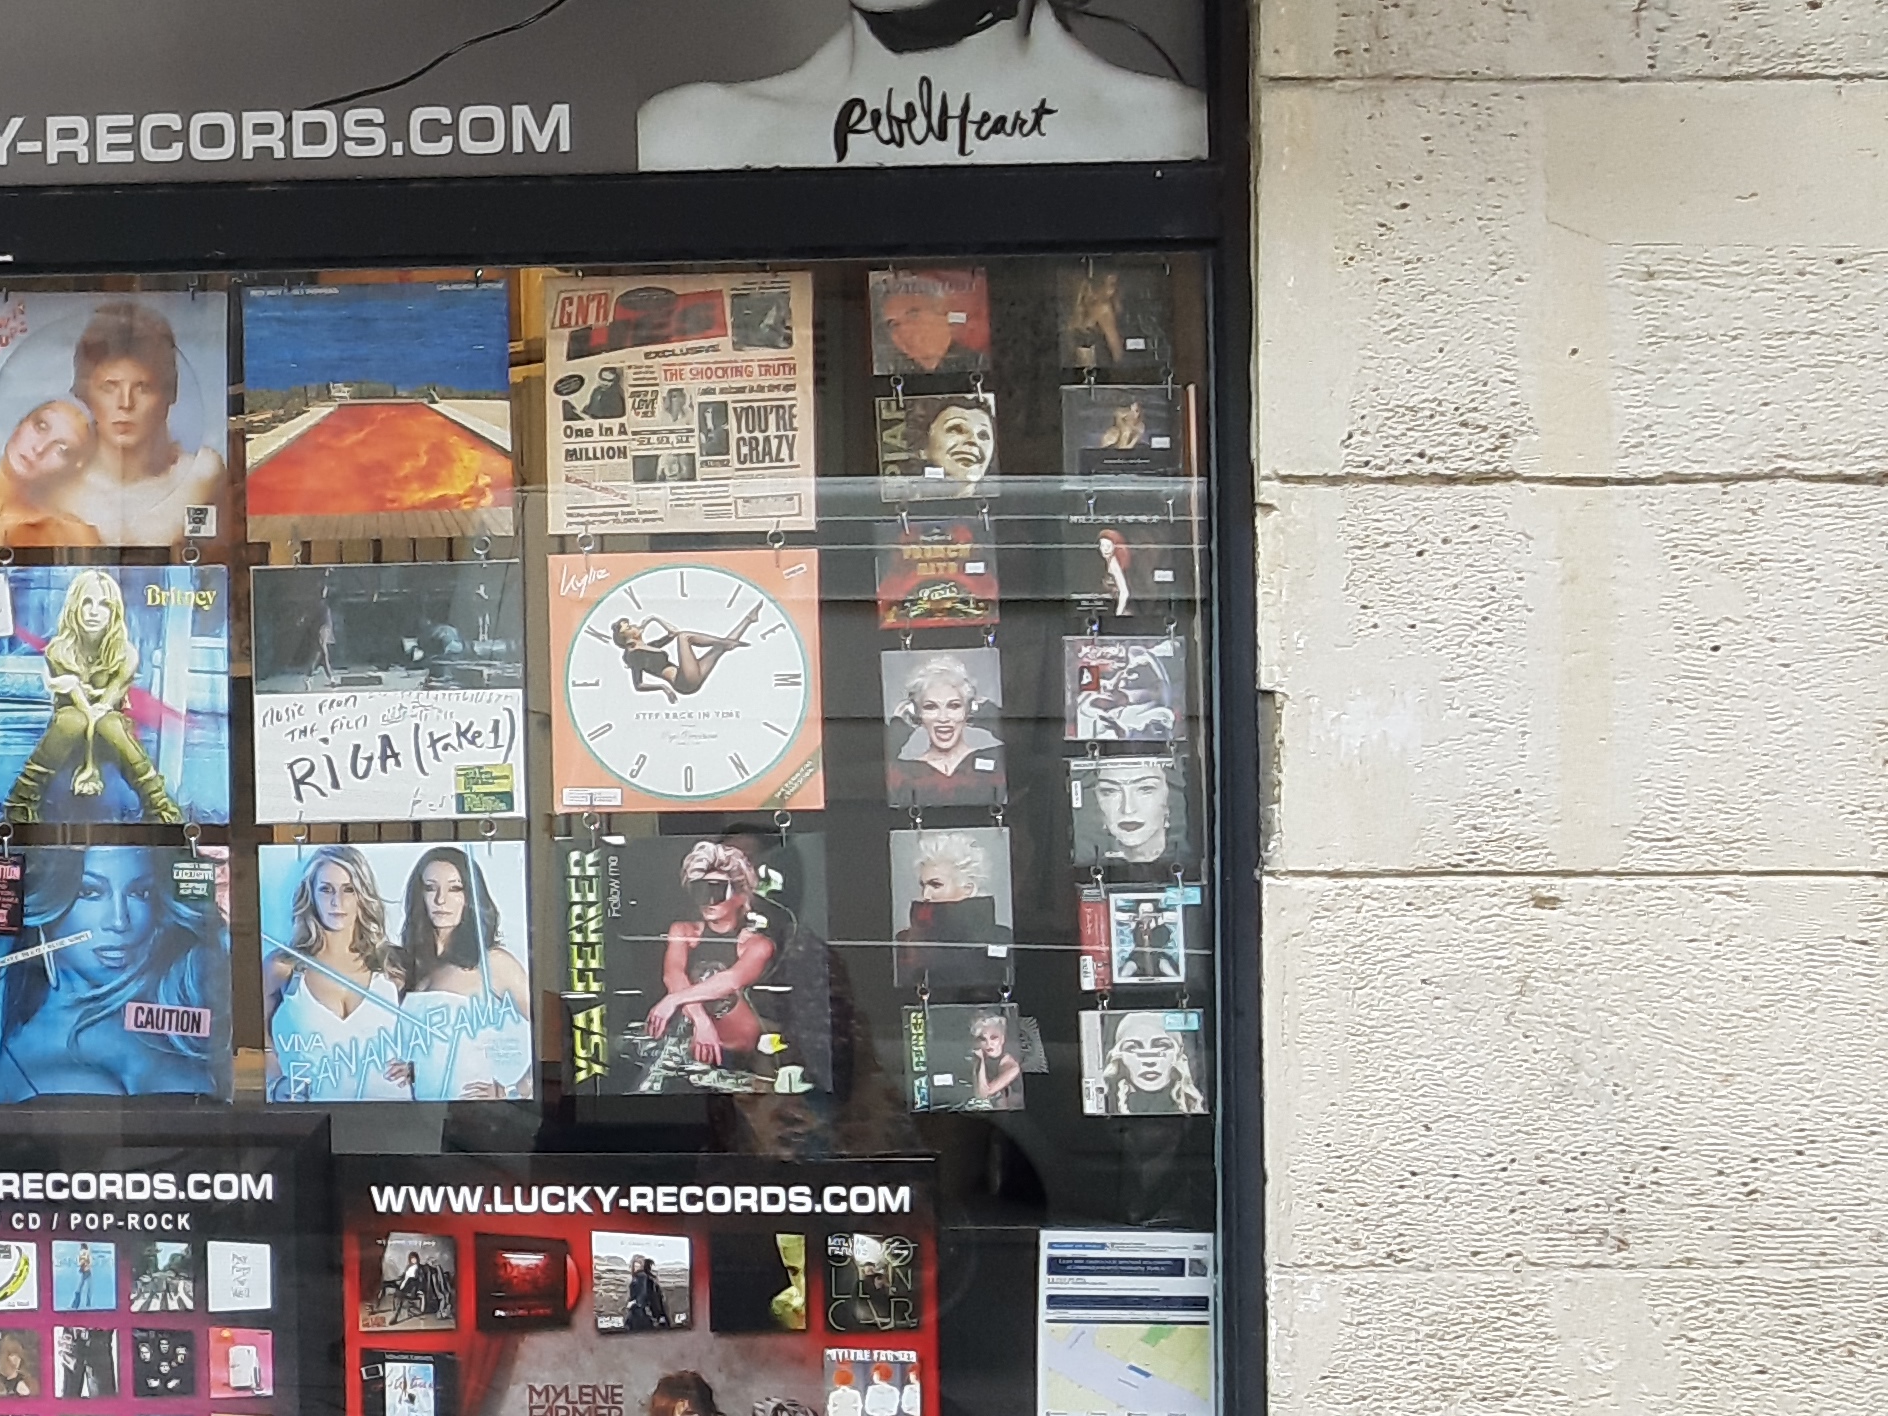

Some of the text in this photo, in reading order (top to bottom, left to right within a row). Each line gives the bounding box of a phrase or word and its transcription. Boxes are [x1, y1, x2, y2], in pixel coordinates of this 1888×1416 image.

[663, 368, 685, 381] THE
[759, 362, 797, 377] TRUTH
[732, 403, 798, 434] YOU'RE
[736, 434, 796, 465] CRAZY
[560, 564, 610, 598] Kylie
[146, 586, 217, 610] Britney
[568, 848, 609, 1084] YSA FERRER
[134, 1005, 202, 1034] CAUTION
[278, 1033, 326, 1052] VIVA
[290, 994, 521, 1096] BANANARAMA
[371, 1186, 909, 1212] WWW.LUCKY-RECORDS.COM
[12, 1213, 40, 1229] CD
[71, 1213, 190, 1230] POP-ROCK
